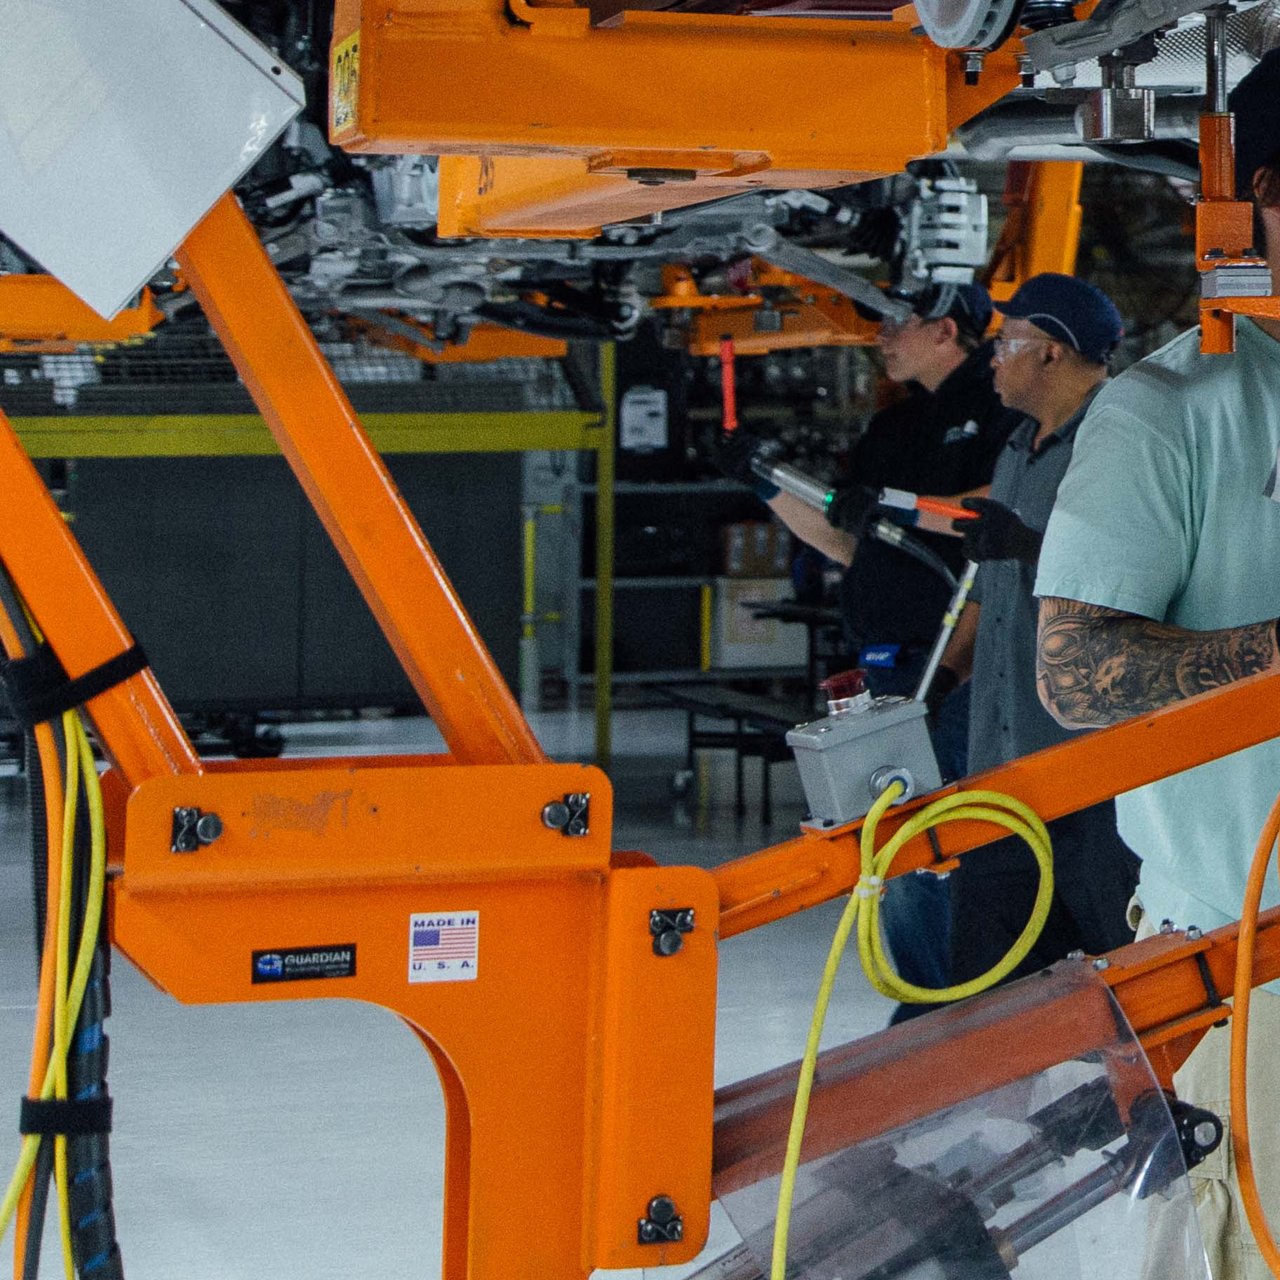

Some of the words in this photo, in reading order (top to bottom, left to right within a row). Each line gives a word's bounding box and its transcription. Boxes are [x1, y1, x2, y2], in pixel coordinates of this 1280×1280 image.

[413, 919, 454, 928] MADE
[461, 918, 476, 927] IN
[285, 951, 350, 966] GUARDIAN
[412, 962, 426, 971] U.
[437, 961, 450, 970] S.
[460, 960, 474, 969] A.
